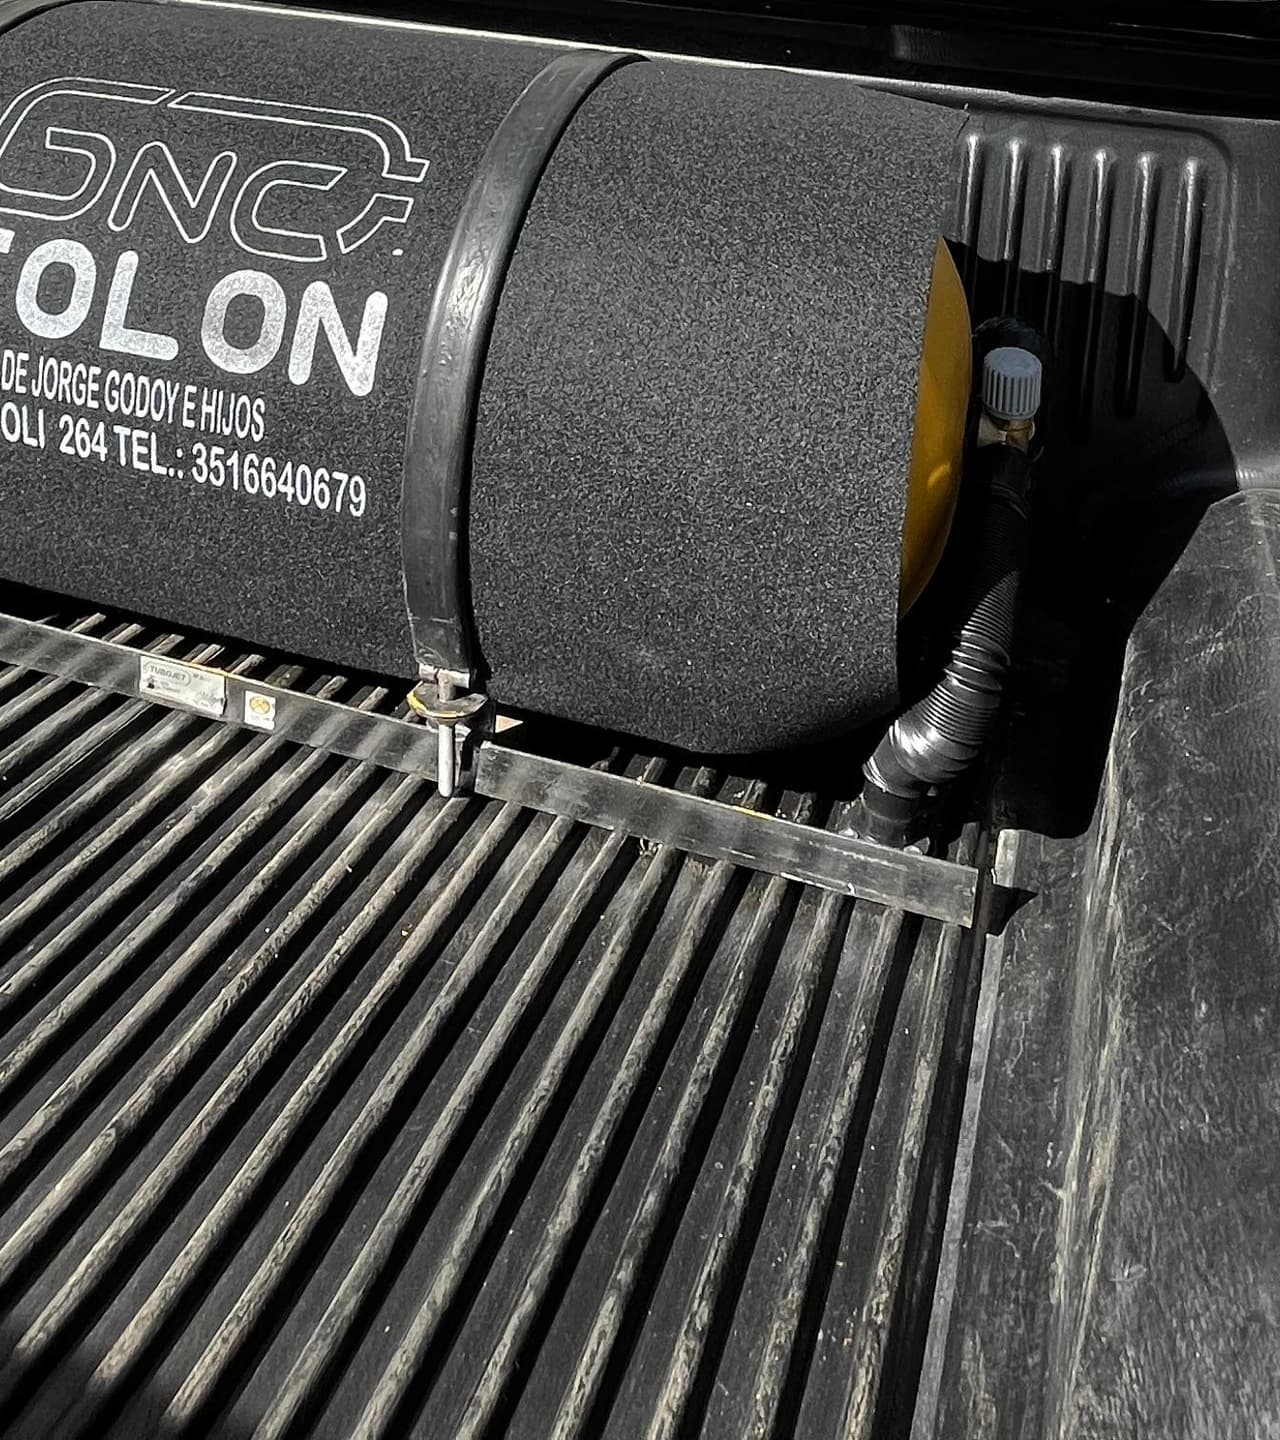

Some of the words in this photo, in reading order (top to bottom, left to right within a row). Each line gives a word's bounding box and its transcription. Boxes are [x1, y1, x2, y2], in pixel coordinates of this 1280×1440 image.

[1, 349, 30, 394] DE
[31, 355, 102, 409] JORGE
[104, 369, 180, 424] GODOY
[182, 384, 198, 429] E
[200, 387, 266, 442] HIJOS
[58, 414, 109, 462] 264
[113, 425, 184, 479] TEL.:
[191, 442, 368, 517] 3516640679
